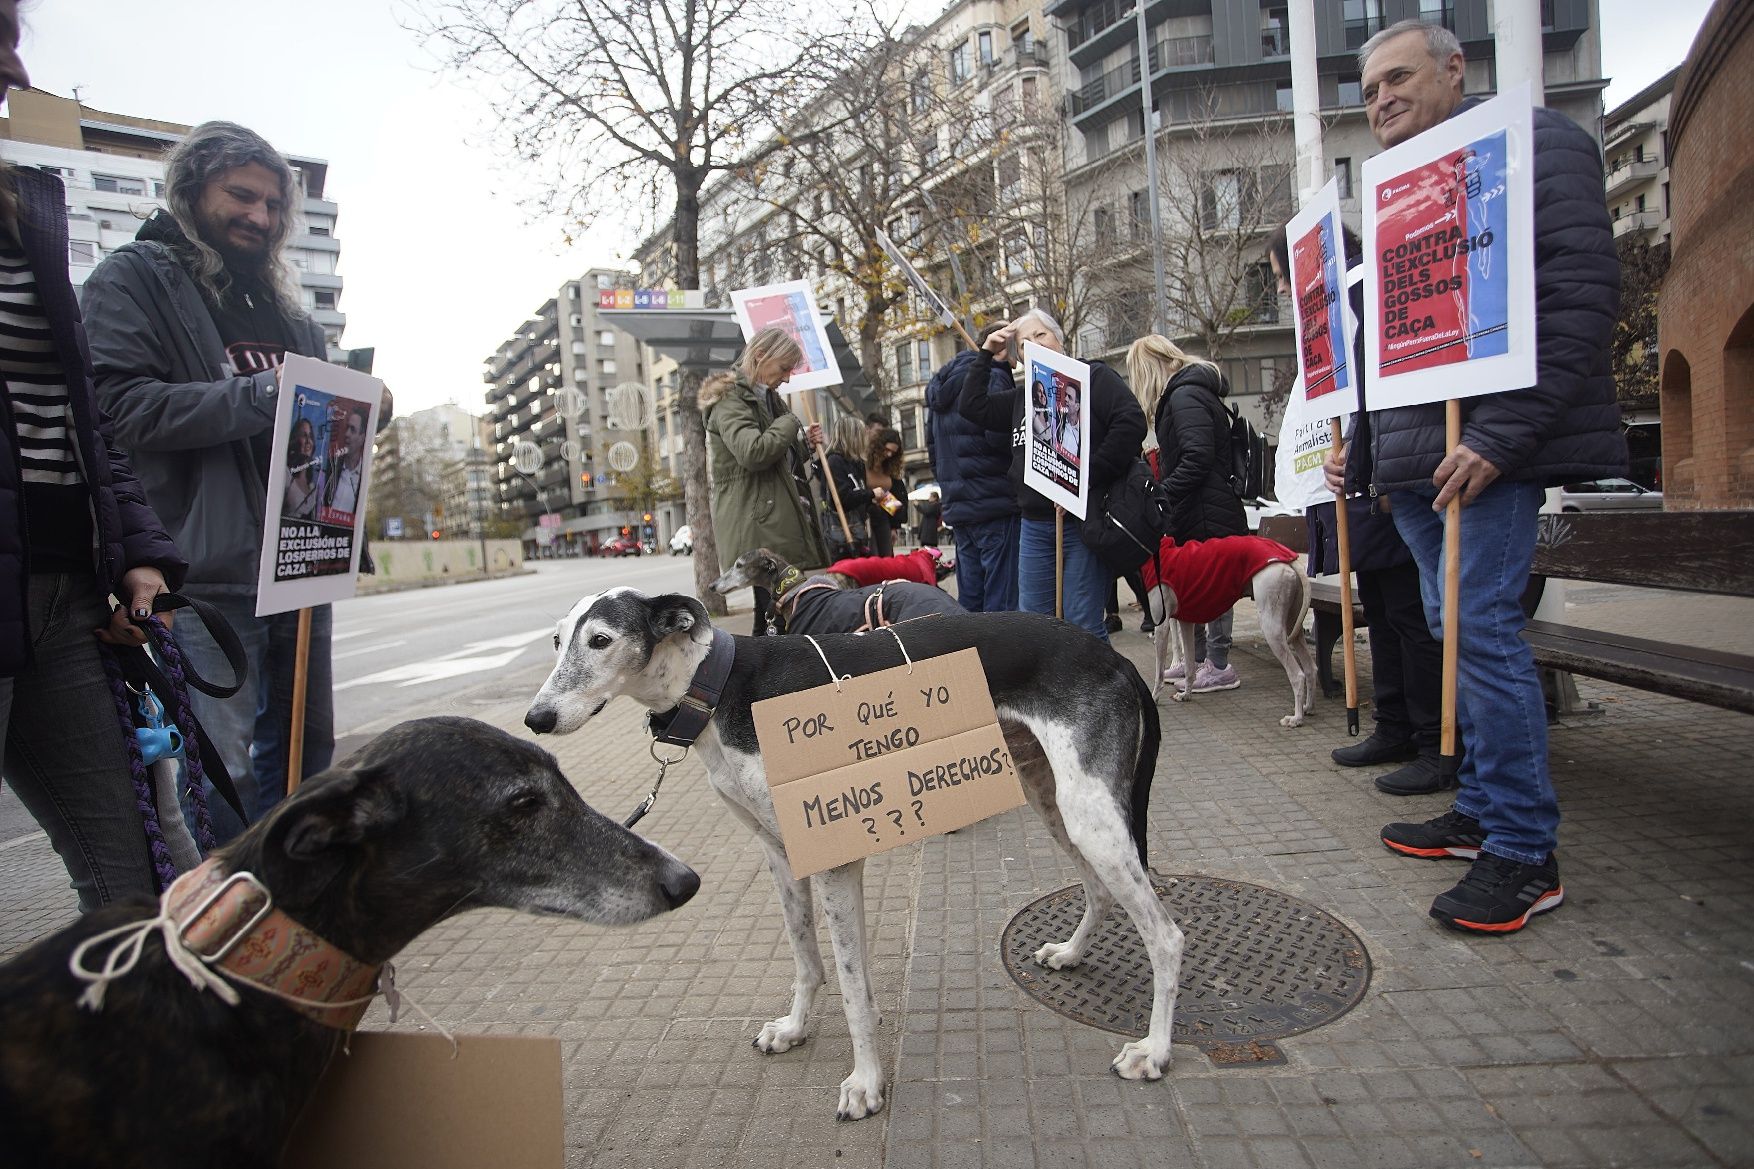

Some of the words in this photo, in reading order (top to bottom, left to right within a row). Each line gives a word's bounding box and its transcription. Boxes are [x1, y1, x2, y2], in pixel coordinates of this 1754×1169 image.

[1405, 222, 1434, 240] Podemos
[1382, 224, 1463, 263] CONTRA
[1383, 226, 1494, 278] L'EXCLUSIÓ
[1384, 268, 1431, 294] DELS
[1300, 282, 1325, 308] CONTRA
[1384, 275, 1463, 309] GOSSOS
[1385, 306, 1408, 325] DE
[1384, 315, 1435, 339] CAÇA
[1304, 344, 1313, 358] DE
[1033, 440, 1042, 450] NO
[1042, 446, 1048, 454] A
[1048, 449, 1057, 458] LA
[1032, 462, 1050, 477] CAZA
[1033, 448, 1067, 472] EXCLUSIÓN
[1067, 466, 1077, 478] DE
[1296, 450, 1327, 471] PACM
[1068, 475, 1078, 486] DE
[280, 534, 335, 550] EXCLUSIÓN
[335, 536, 349, 547] DE
[281, 526, 297, 538] NO
[298, 526, 305, 538] A
[306, 526, 320, 537] LA
[337, 548, 350, 558] DE
[277, 563, 306, 577] CAZA
[782, 712, 834, 744] POR
[857, 691, 898, 725] QUÉ
[920, 686, 949, 708] YO
[848, 726, 920, 760] TENGO
[803, 782, 884, 828] MENOS
[907, 748, 1013, 797] DERECHOS?
